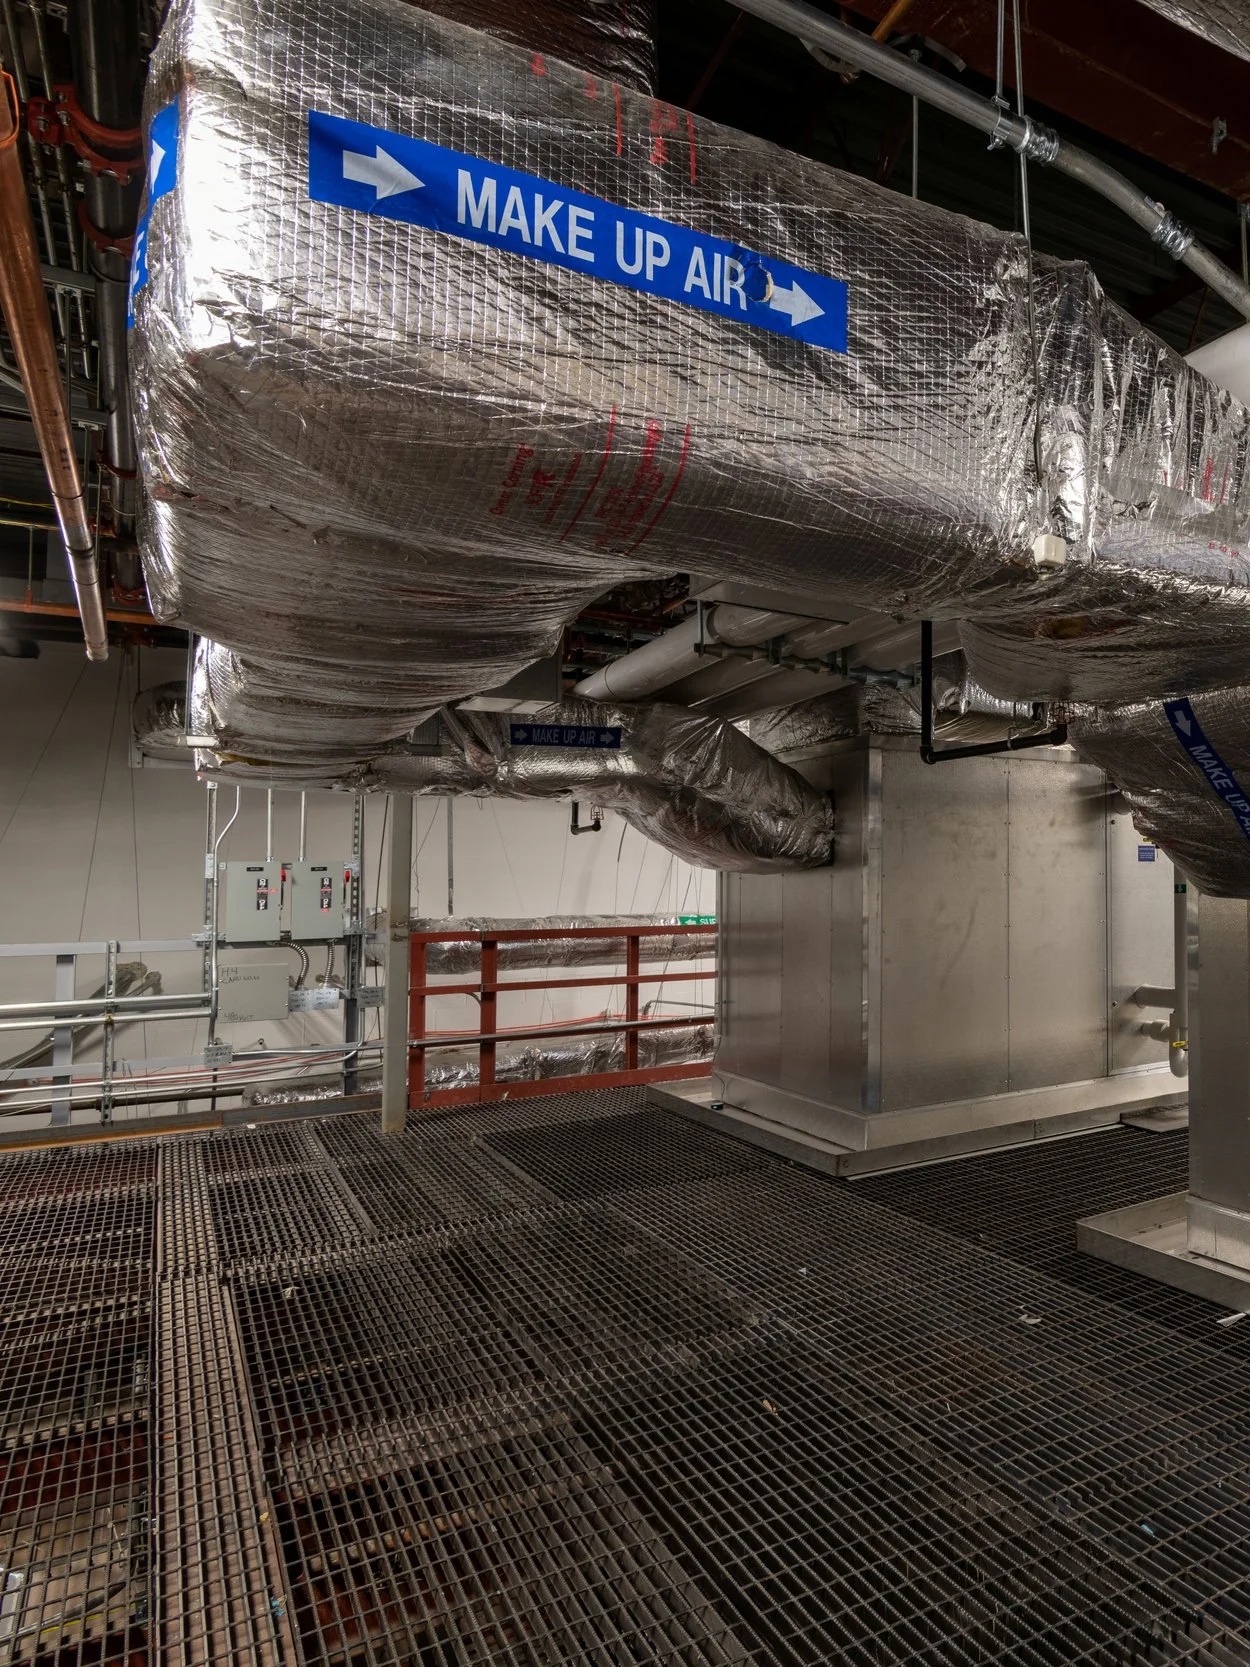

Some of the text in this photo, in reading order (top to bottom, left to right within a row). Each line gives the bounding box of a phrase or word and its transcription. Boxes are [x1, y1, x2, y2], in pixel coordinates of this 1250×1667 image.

[457, 168, 748, 311] MAKE UP AIR
[532, 727, 597, 745] MAKE UP AIR
[1189, 744, 1234, 790] MAKE
[1225, 793, 1250, 813] UP
